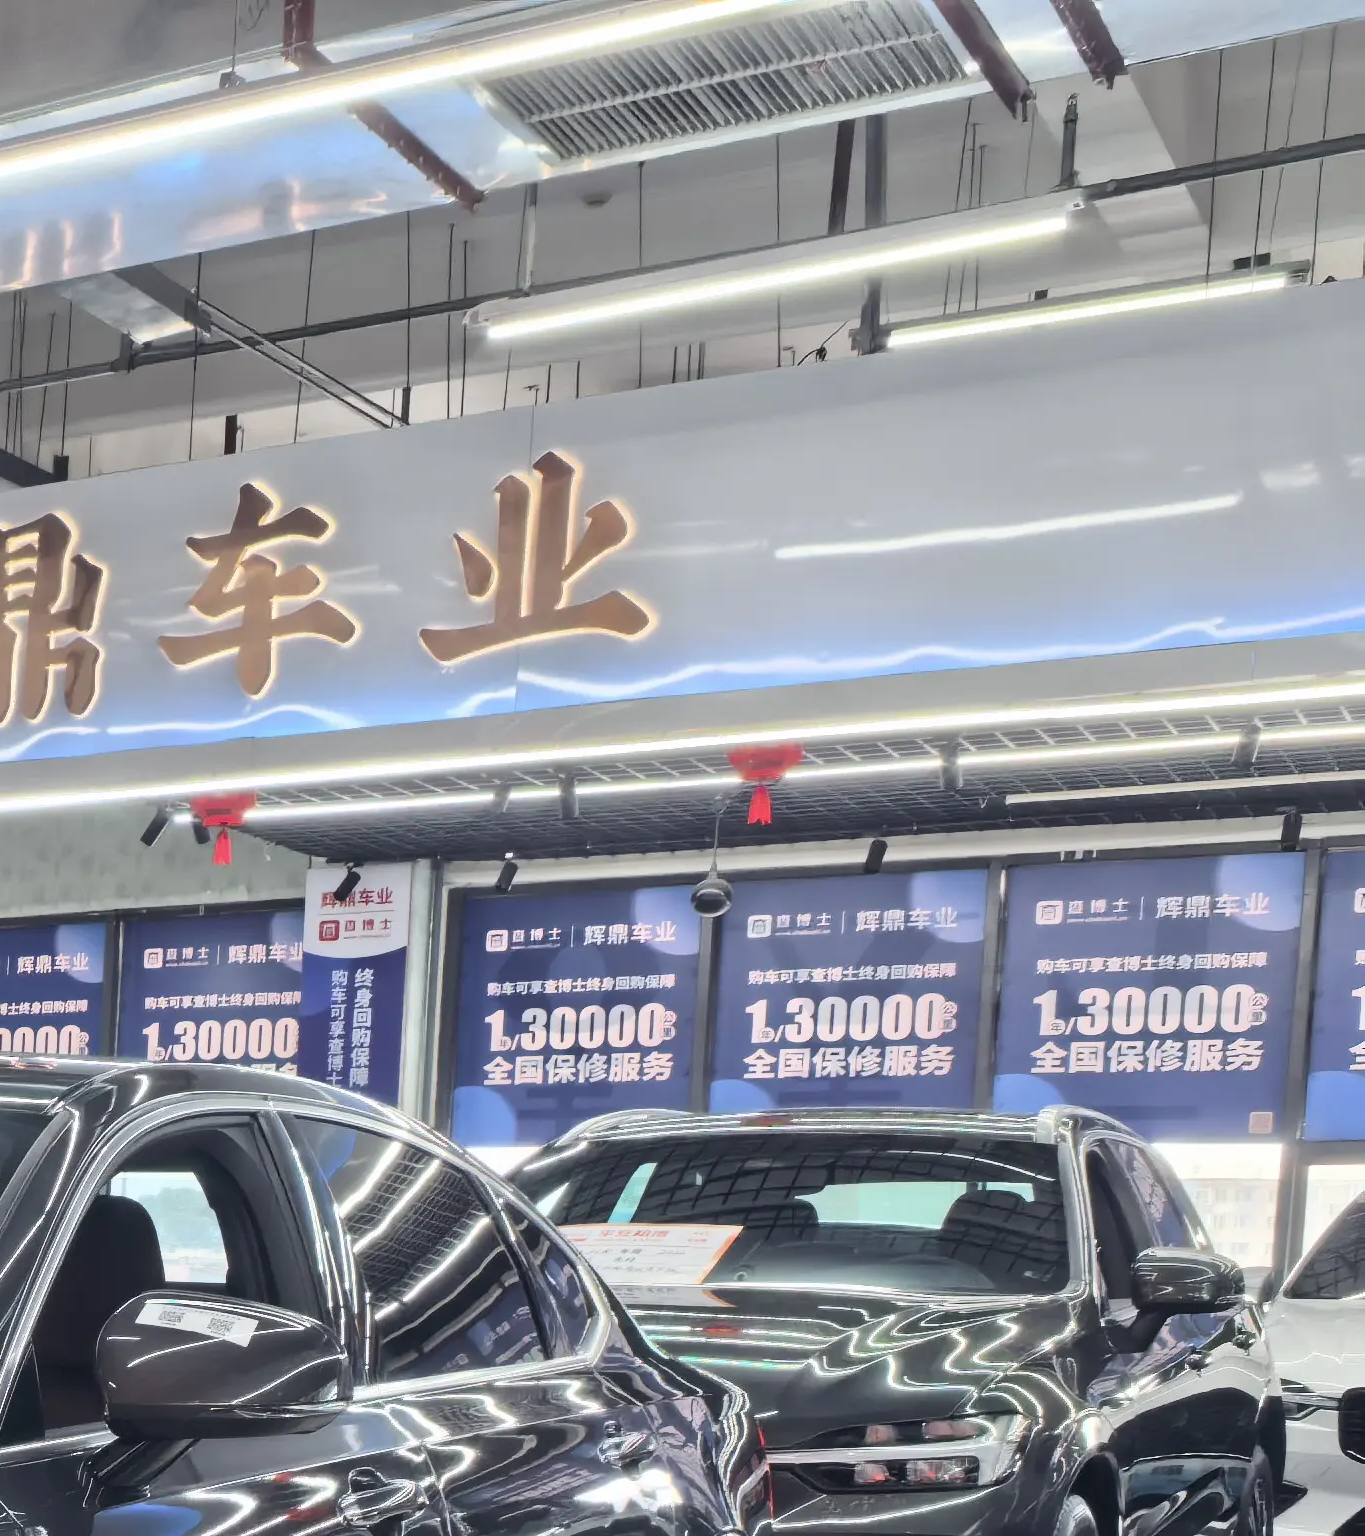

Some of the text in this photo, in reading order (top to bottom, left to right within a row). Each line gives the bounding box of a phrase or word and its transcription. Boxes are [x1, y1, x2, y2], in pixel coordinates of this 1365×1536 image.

[855, 906, 959, 932] 辉鼎车业
[1154, 892, 1271, 920] 辉鼎车业
[583, 920, 677, 946] 辉鼎车业
[17, 952, 90, 975] 辉鼎车业
[747, 962, 958, 986] 购车可享查博士终身回购保障
[1035, 951, 1269, 976] 购车可享查博士终身回购保障
[487, 973, 676, 997] 购车可享查博士终身回购保障
[349, 967, 375, 1090] 终身回购保障
[483, 1050, 674, 1086] 全国保修服务
[743, 1044, 957, 1080] 全国保修服务
[1029, 1037, 1265, 1075] 全国保修服务
